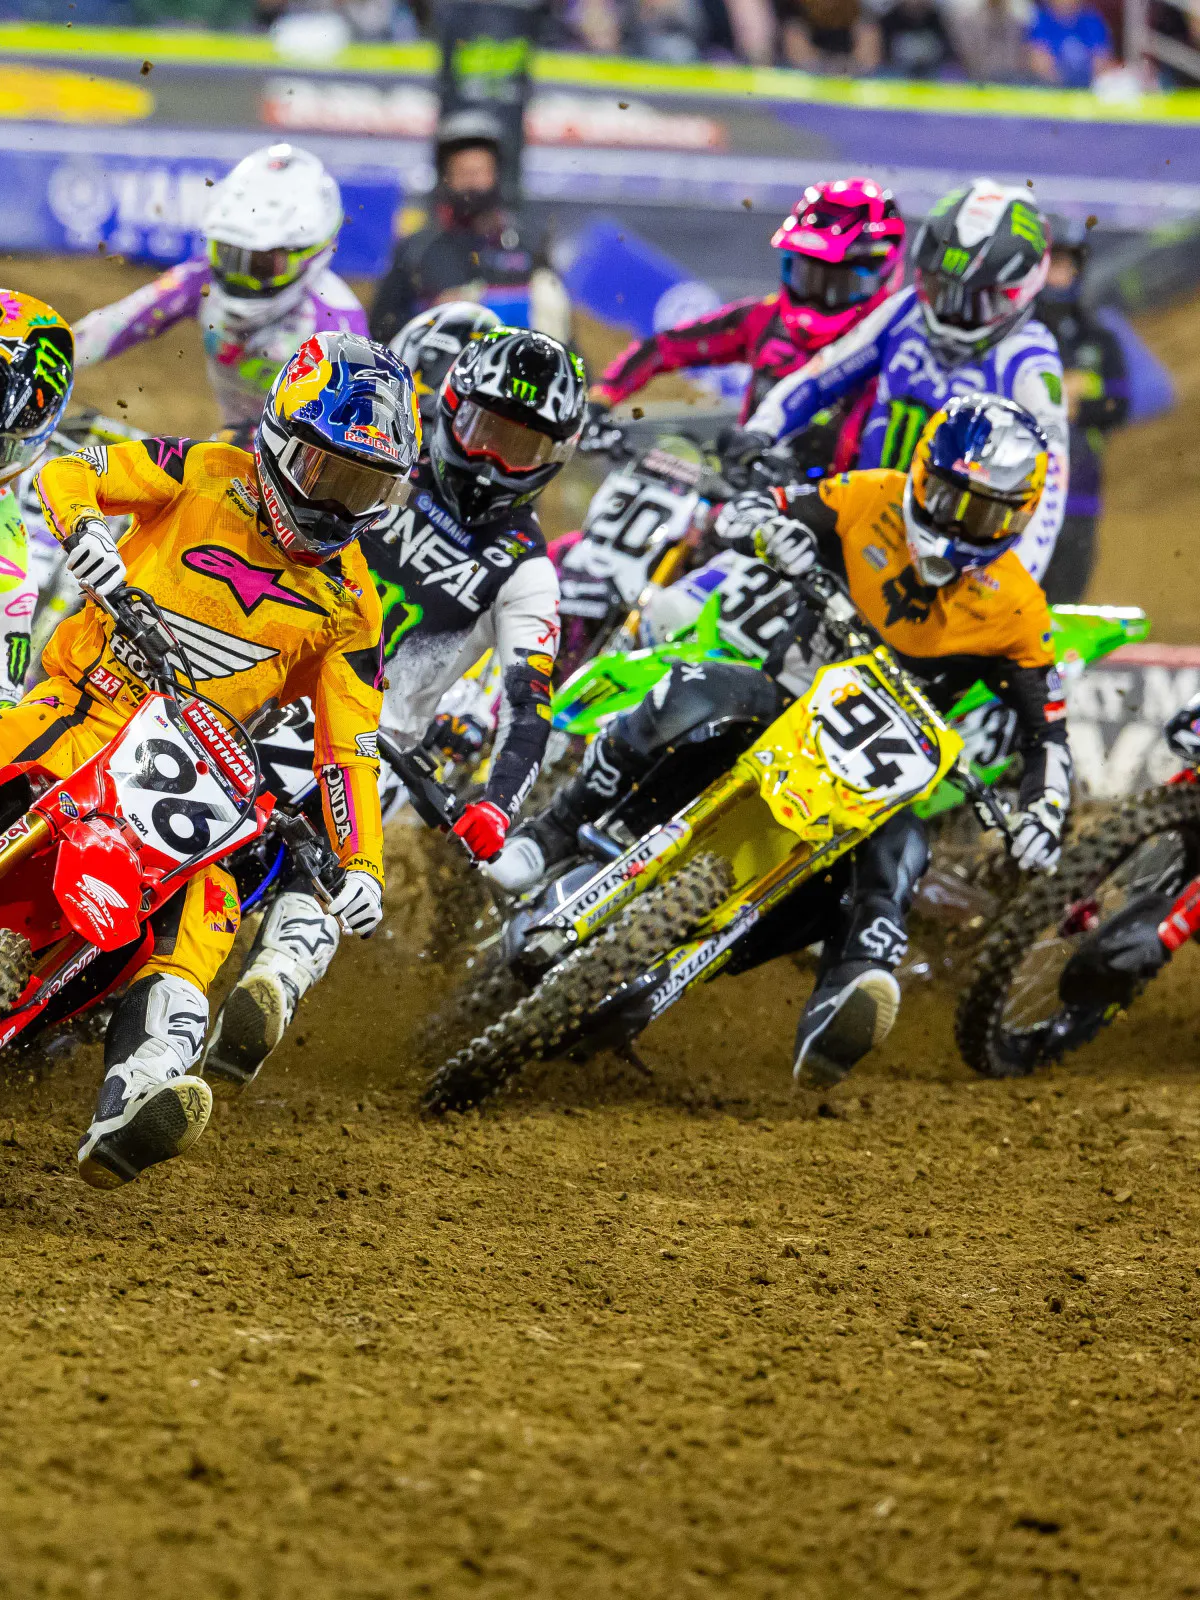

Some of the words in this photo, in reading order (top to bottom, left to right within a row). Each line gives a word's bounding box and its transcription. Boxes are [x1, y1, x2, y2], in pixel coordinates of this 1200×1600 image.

[345, 430, 372, 448] Red
[372, 436, 399, 459] Bull
[429, 505, 472, 547] YAMAHA
[188, 708, 255, 787] RENTHAL
[188, 735, 229, 788] SUPERCROSS
[198, 701, 258, 778] RENTHA
[813, 690, 917, 789] 94
[129, 813, 149, 837] SKDA
[130, 738, 227, 855] 96
[75, 880, 115, 929] HONDA
[573, 846, 653, 917] DUNLOP
